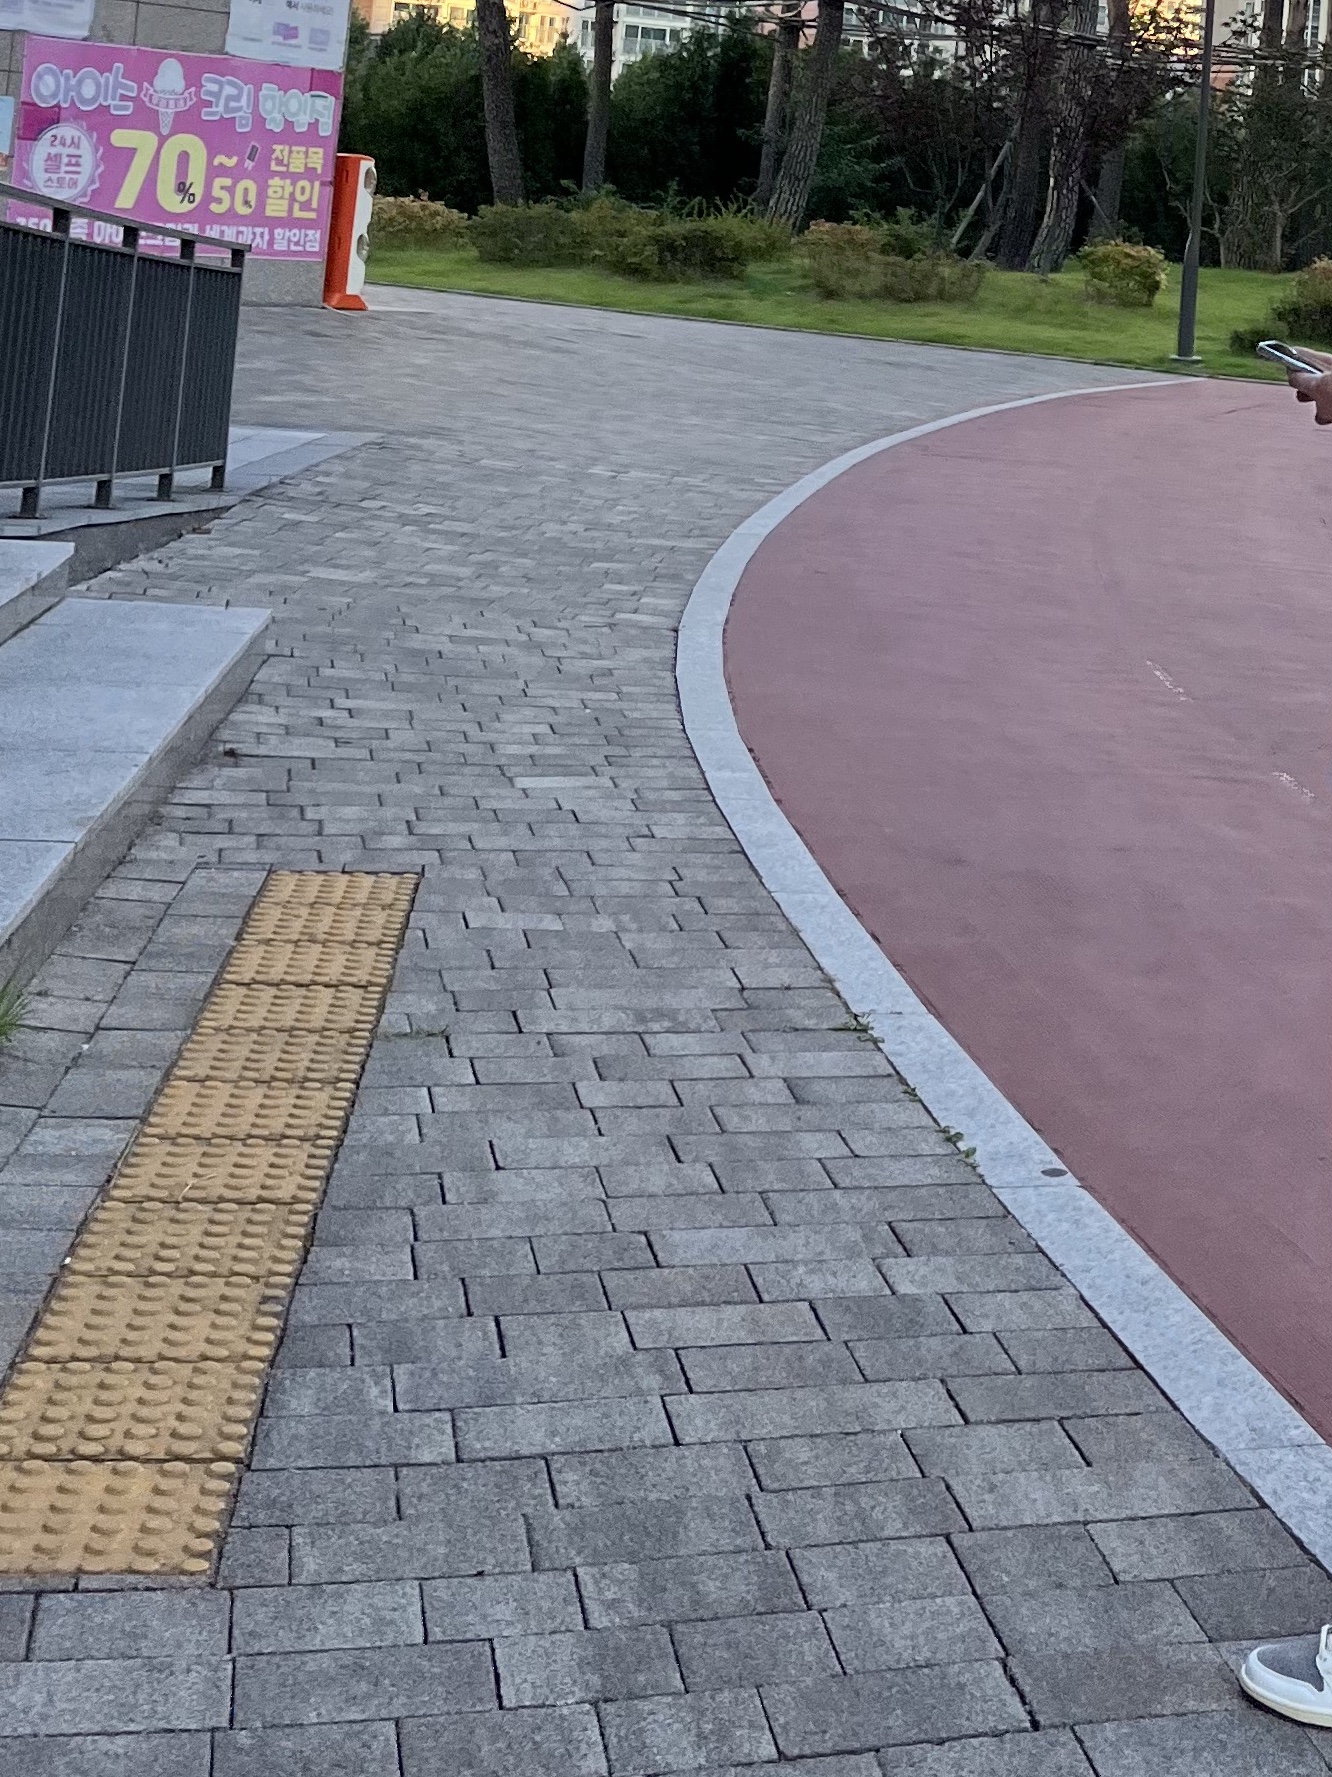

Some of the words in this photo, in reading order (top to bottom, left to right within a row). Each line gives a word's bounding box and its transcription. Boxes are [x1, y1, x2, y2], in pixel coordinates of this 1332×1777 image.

[44, 152, 83, 174] 셀프
[270, 143, 324, 174] 전품목
[43, 177, 79, 190] 스토어
[264, 176, 320, 219] 할인
[273, 227, 322, 253] 할인점
